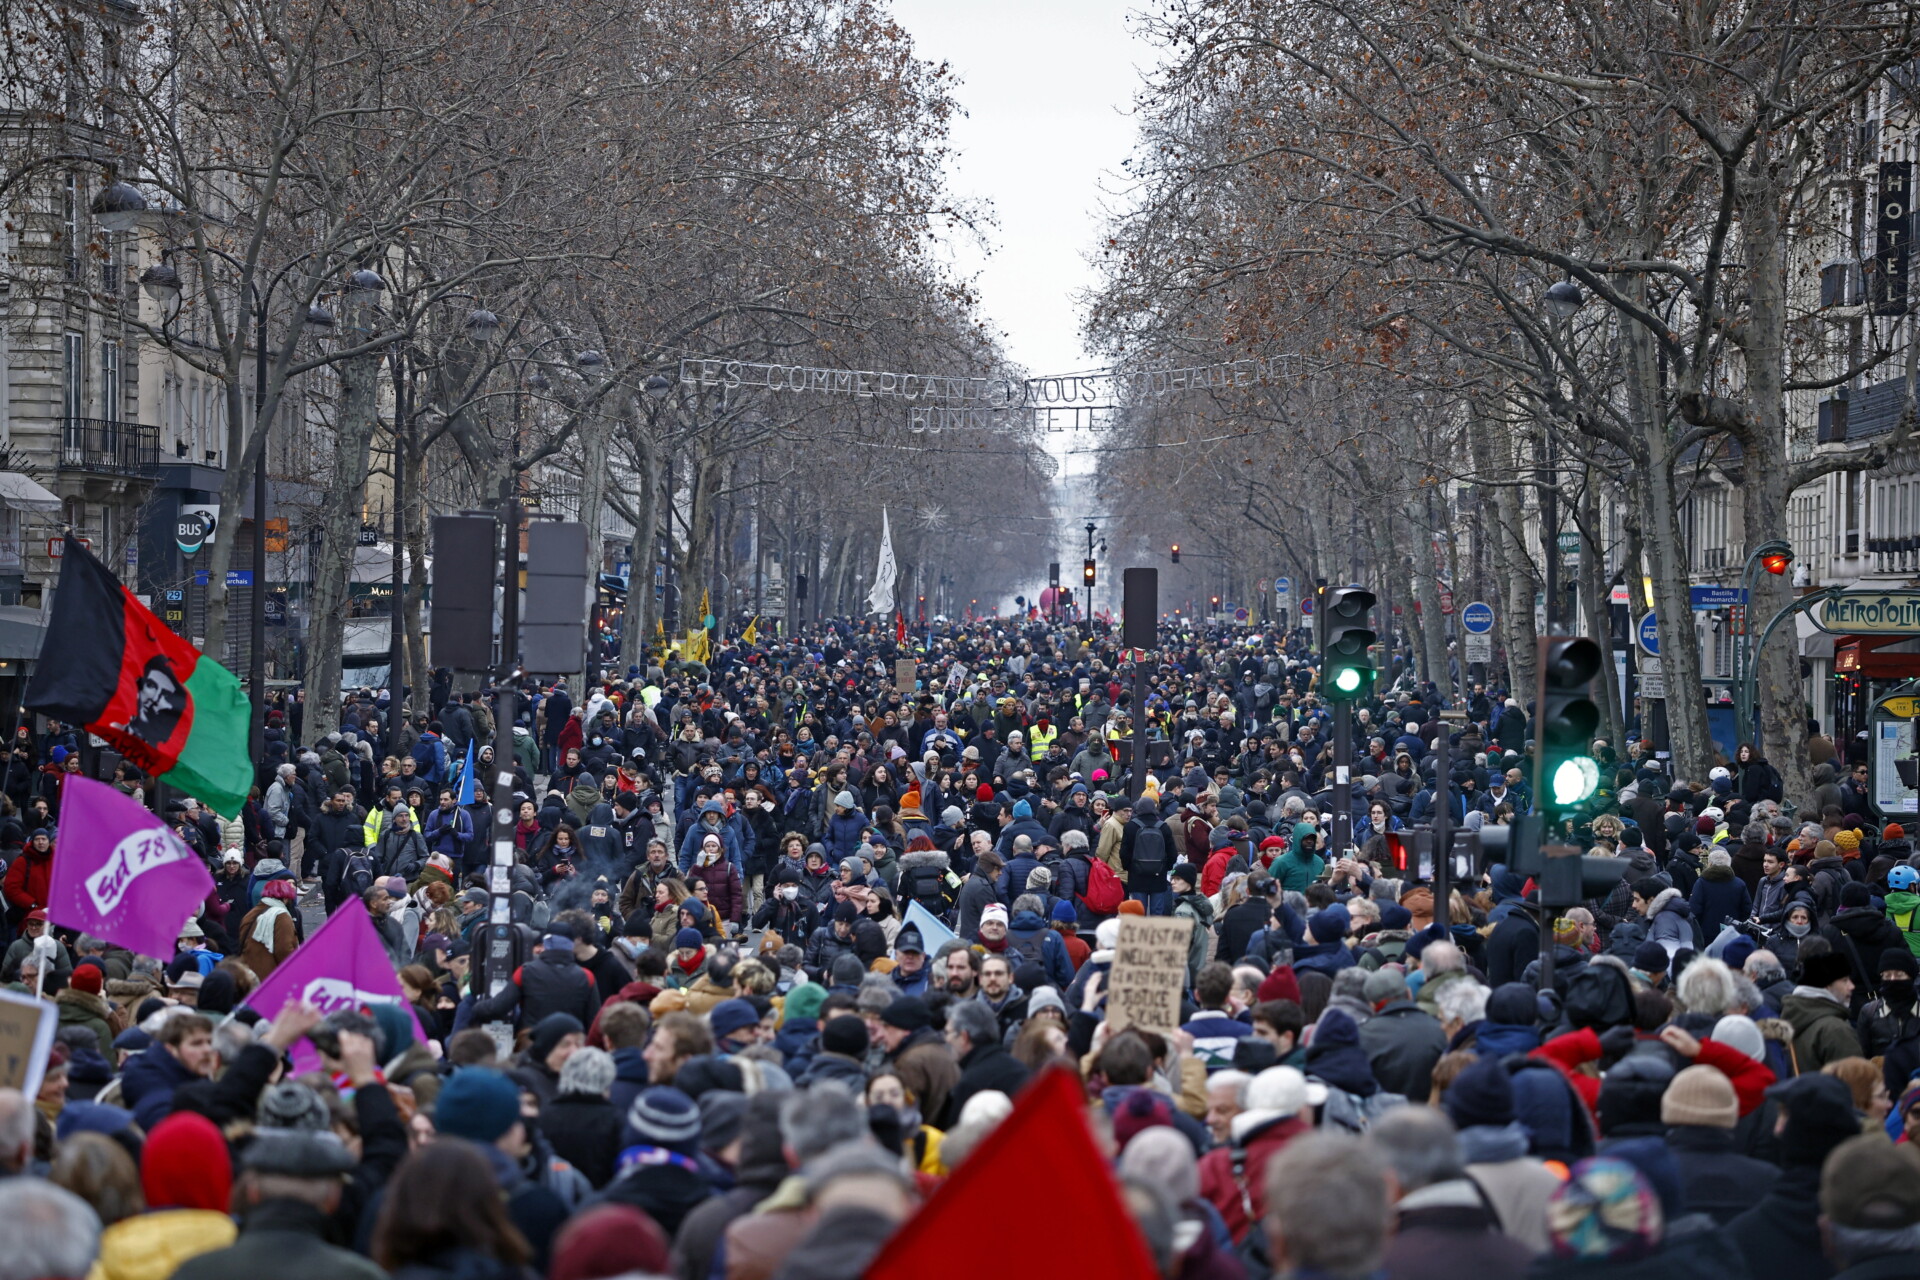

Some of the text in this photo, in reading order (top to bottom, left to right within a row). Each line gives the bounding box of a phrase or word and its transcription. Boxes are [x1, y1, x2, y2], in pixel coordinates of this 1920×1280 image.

[1885, 175, 1903, 302] HOTEL
[680, 358, 743, 388] LES
[1025, 376, 1097, 403] VOUS
[910, 406, 1025, 434] BONNES
[178, 523, 202, 536] BUS
[168, 591, 181, 600] 29
[168, 611, 181, 620] 91
[1826, 597, 1920, 627] METROPOLIT
[138, 836, 167, 865] 78
